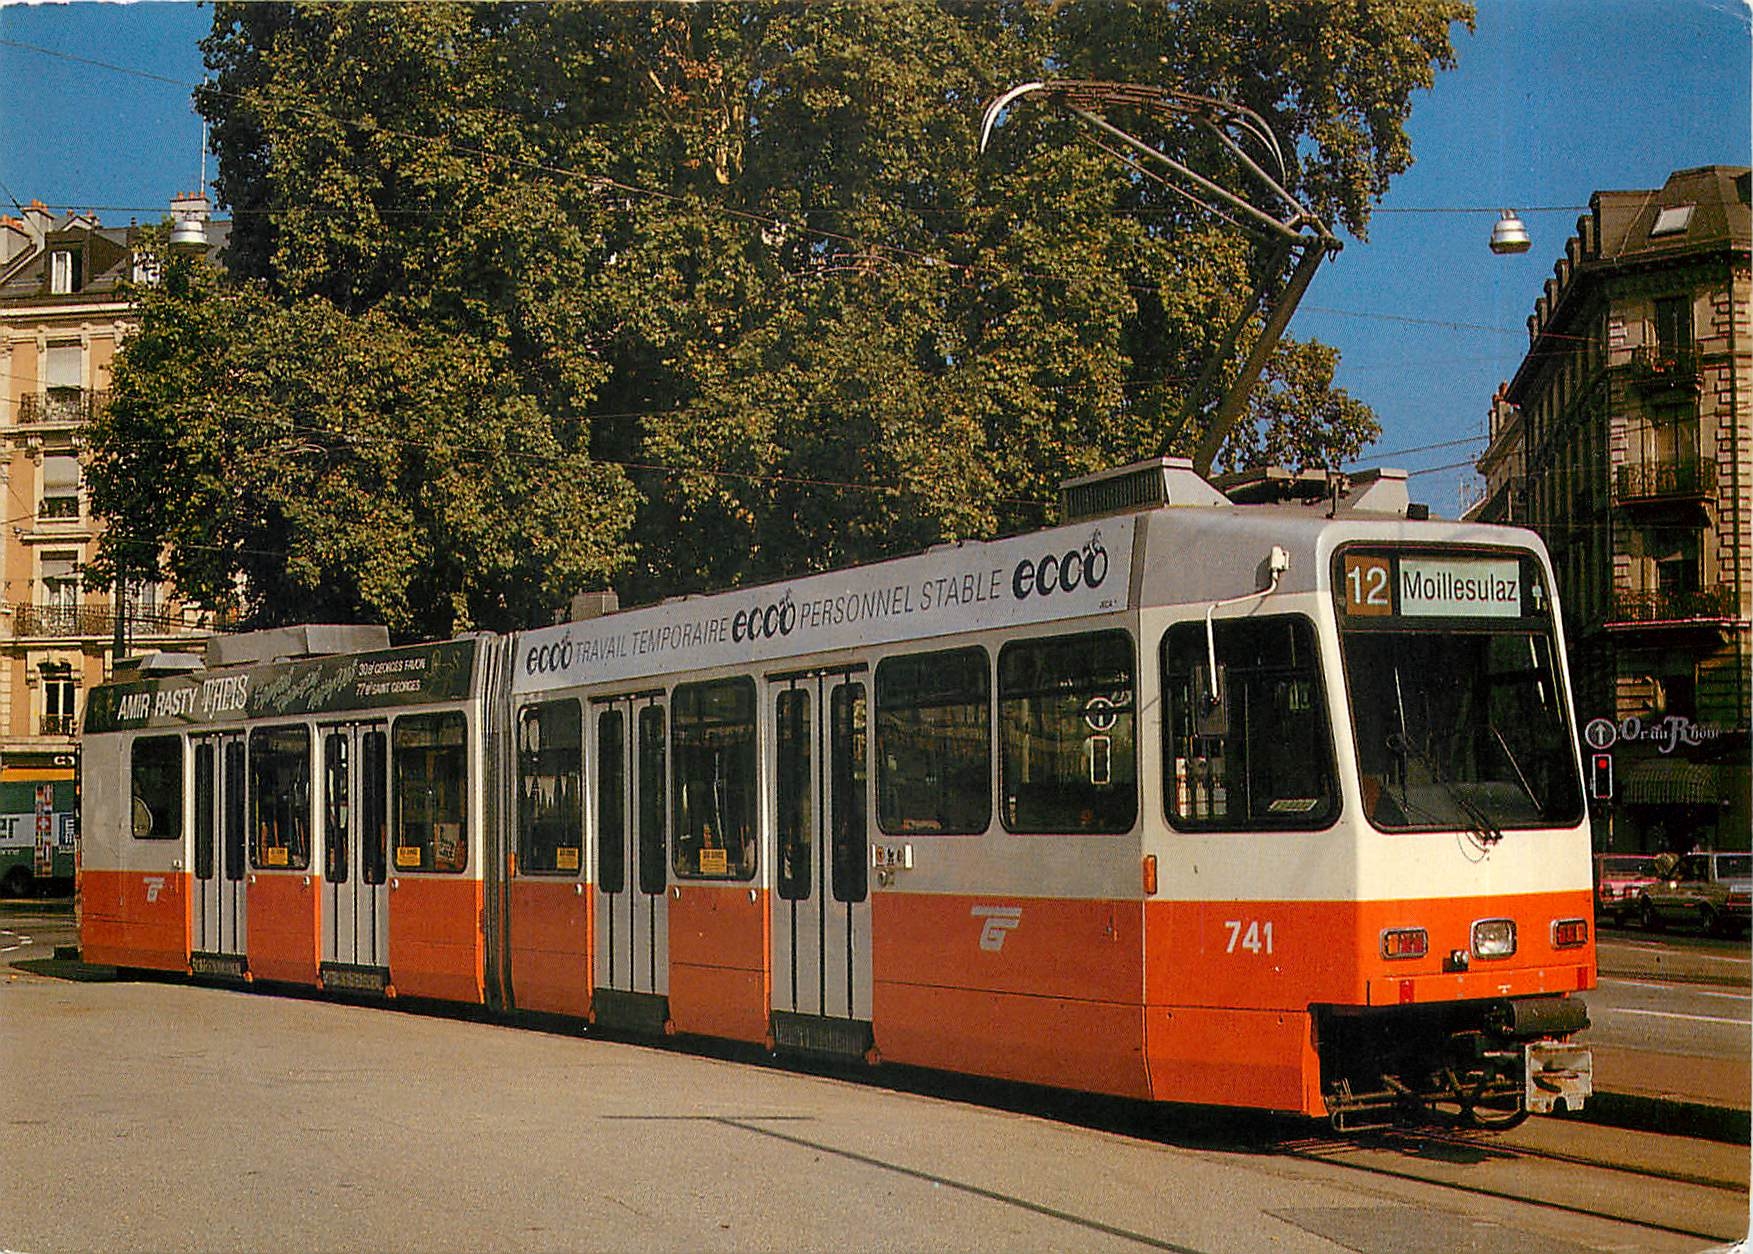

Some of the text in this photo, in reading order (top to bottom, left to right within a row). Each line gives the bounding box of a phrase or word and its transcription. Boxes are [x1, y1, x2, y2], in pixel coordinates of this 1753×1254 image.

[1347, 566, 1517, 605] 12 Moillesulaz
[526, 543, 1109, 675] ecco TRAVAIL TEMPORAIRE ecco PERSONNEL STABLE ecco
[117, 694, 150, 720] AMIR
[154, 687, 198, 716] RASTY
[1224, 920, 1274, 955] 741
